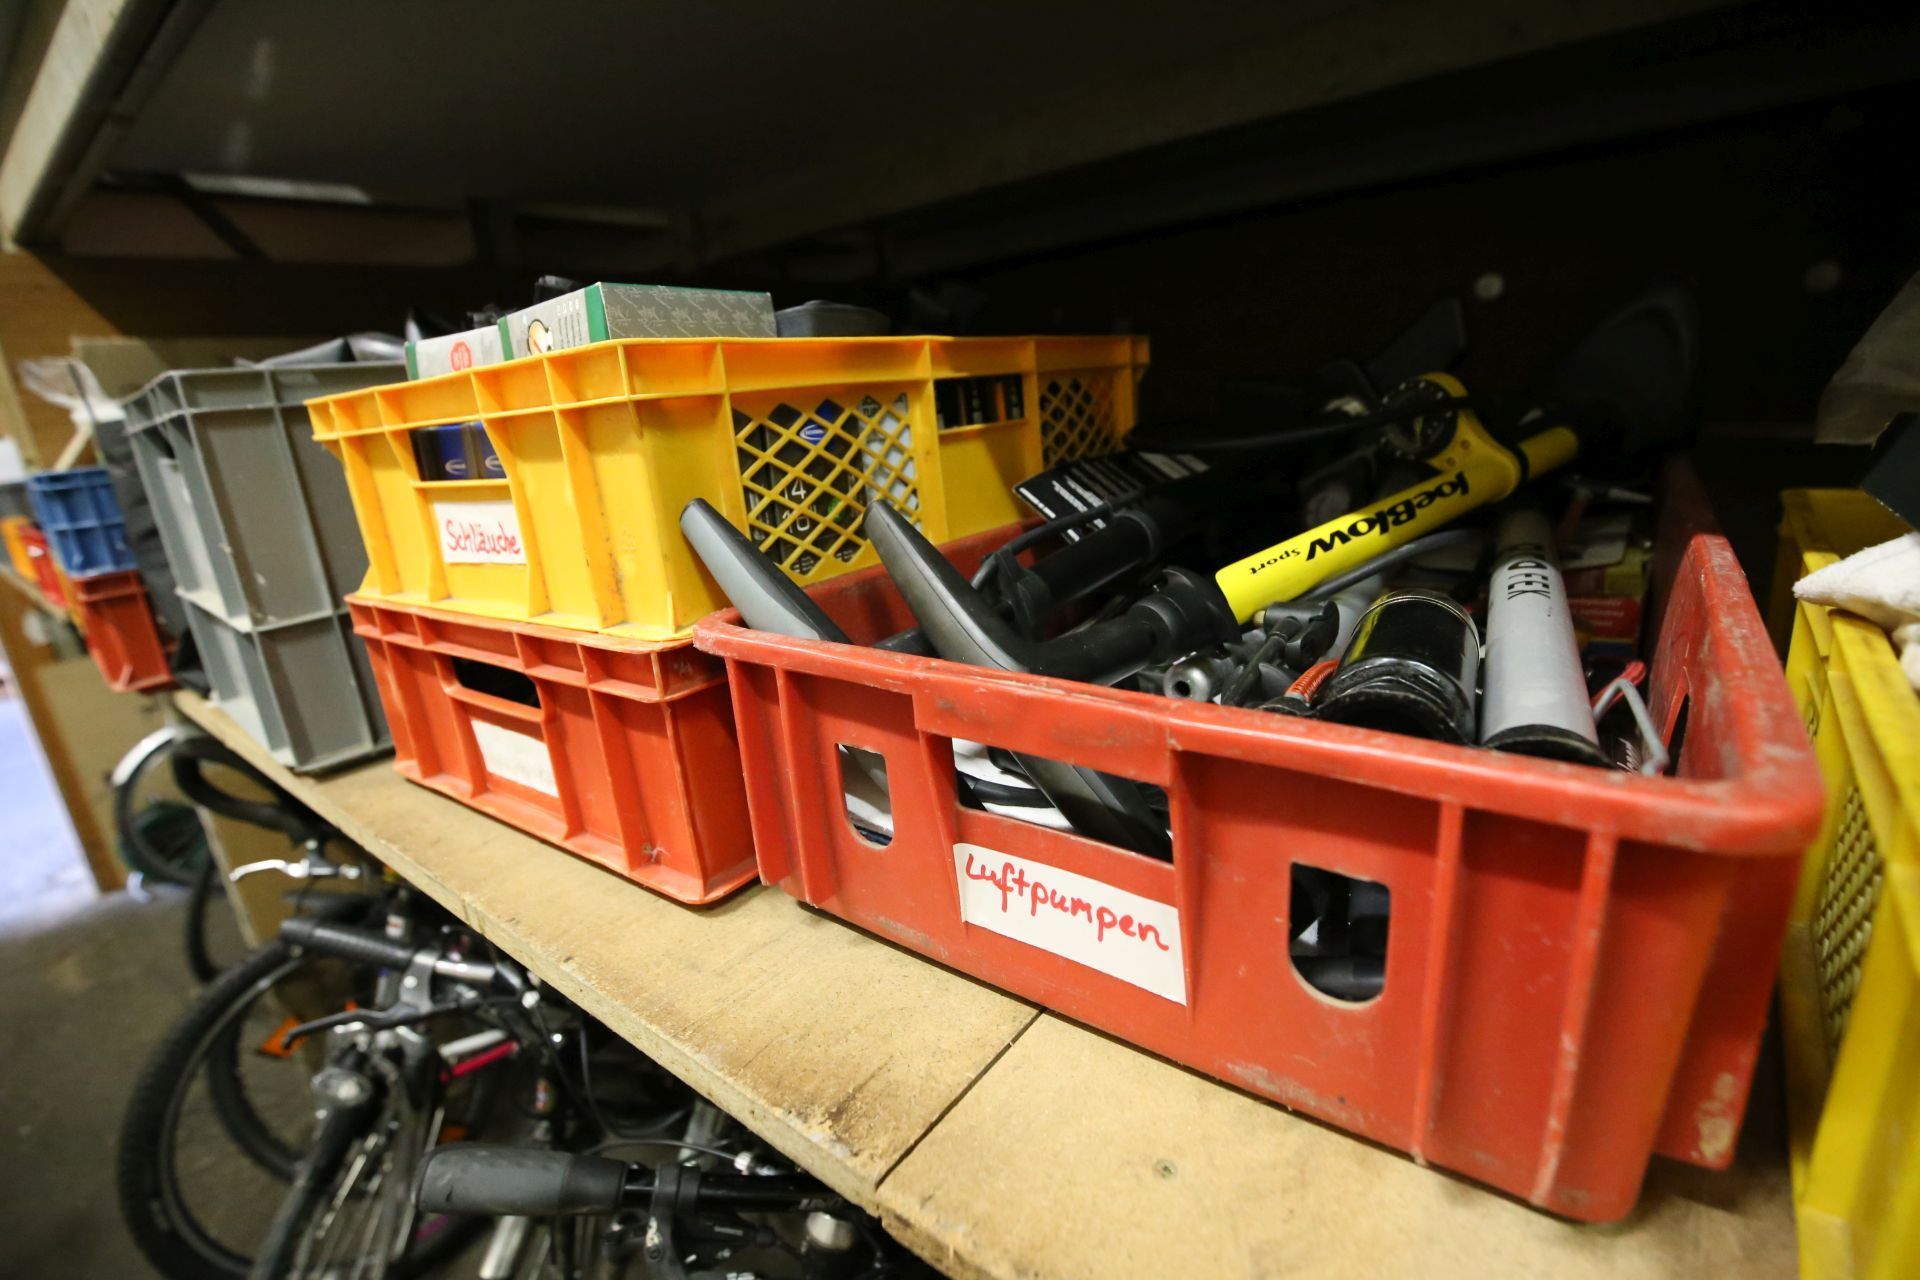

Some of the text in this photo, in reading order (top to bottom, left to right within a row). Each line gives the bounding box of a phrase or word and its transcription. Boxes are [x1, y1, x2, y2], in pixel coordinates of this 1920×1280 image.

[446, 519, 520, 554] Schläuche
[1249, 472, 1470, 575] JoeBlow Sport
[965, 853, 1170, 951] Luftpumpen
